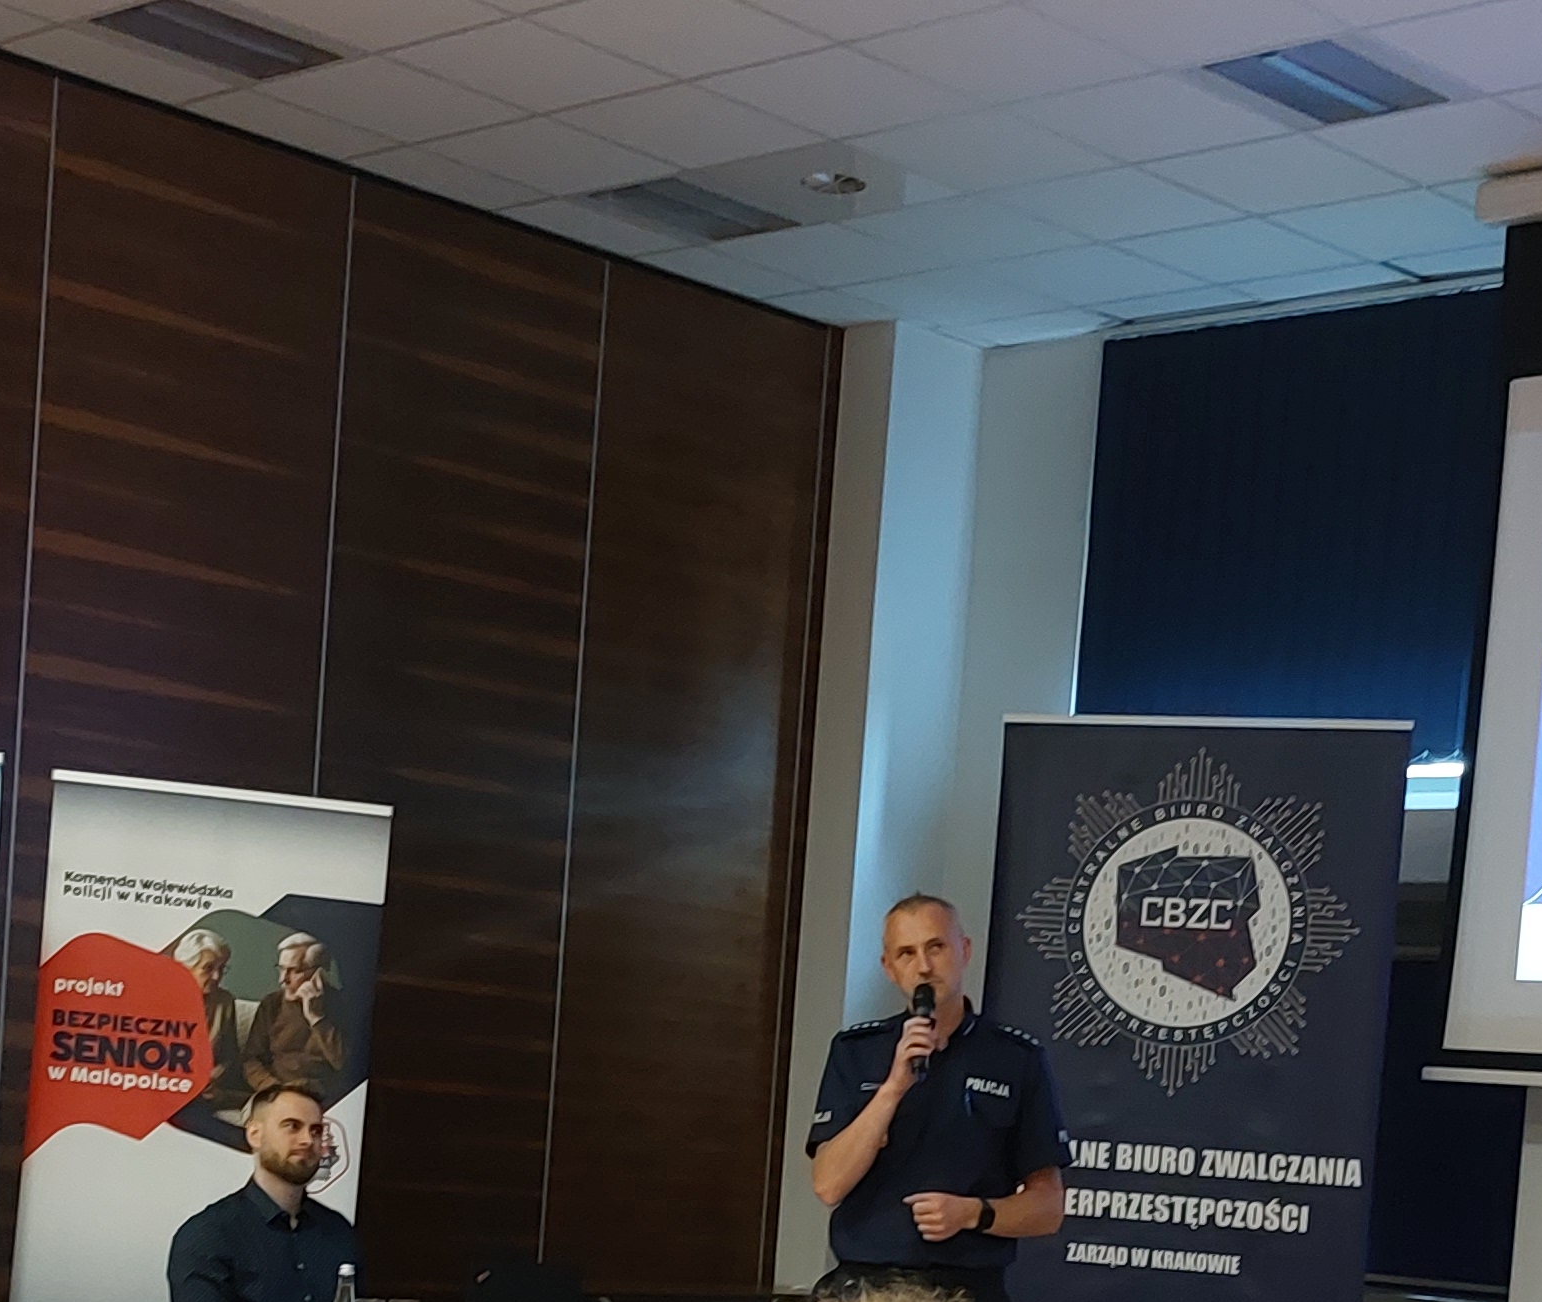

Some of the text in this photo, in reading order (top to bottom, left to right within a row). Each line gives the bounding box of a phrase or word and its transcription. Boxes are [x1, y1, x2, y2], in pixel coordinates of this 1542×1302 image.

[1153, 803, 1225, 821] BIURO
[63, 884, 212, 910] Policji w Krakowie
[64, 870, 234, 900] Komenda Wojewódzka
[1140, 896, 1233, 930] CBZC
[54, 977, 125, 998] projekt
[51, 1009, 198, 1039] BEZPIECZNY
[50, 1031, 193, 1073] SENIOR
[48, 1066, 193, 1093] w Małopolsce
[965, 1077, 1010, 1098] POLICJA
[1069, 1140, 1363, 1188] LNE BIURO ZWALCZANIA
[1064, 1188, 1310, 1234] ERPRZESTĘPCZOŚCI
[1065, 1241, 1241, 1275] ZARZĄD W KRAKOWIE
